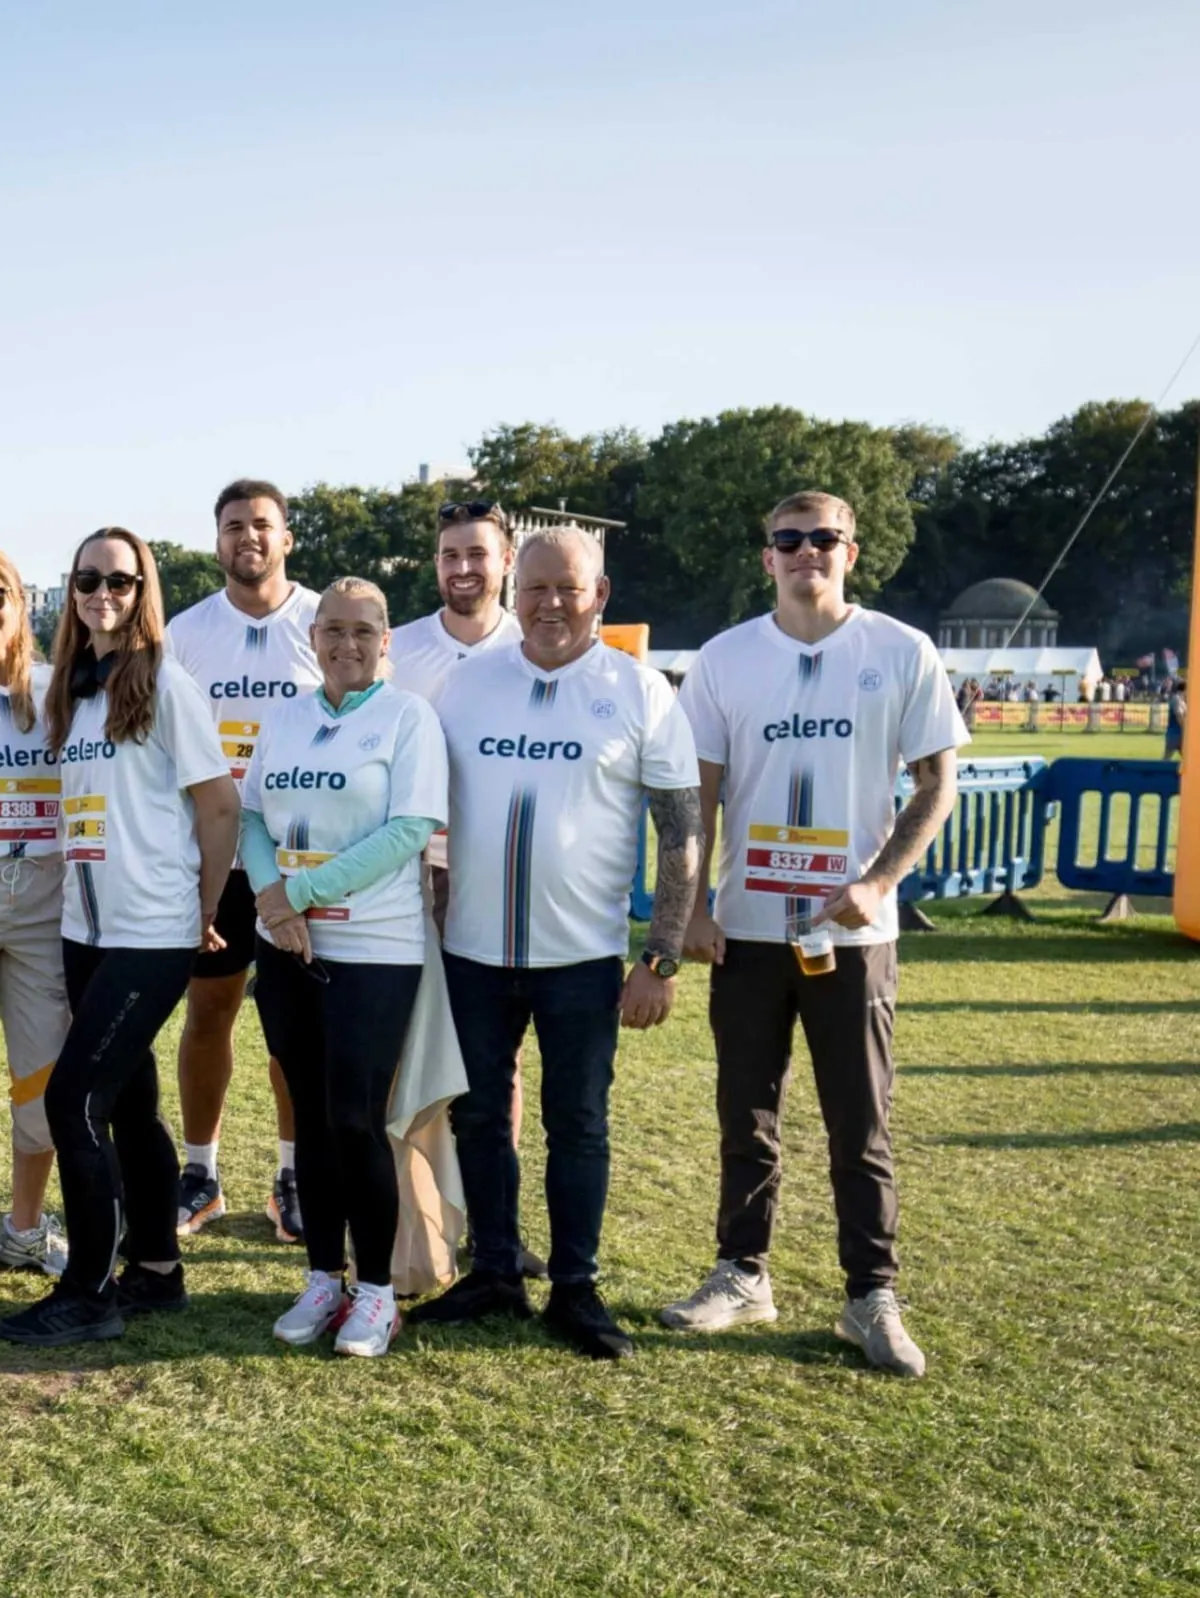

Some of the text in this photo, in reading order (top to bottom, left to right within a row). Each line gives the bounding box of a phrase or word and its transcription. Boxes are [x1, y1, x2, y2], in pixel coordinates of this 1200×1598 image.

[210, 675, 298, 699] celero
[764, 713, 853, 742] celero
[478, 733, 583, 760] celero
[264, 766, 347, 790] celero
[0, 802, 36, 817] 8388
[770, 851, 814, 870] 8337
